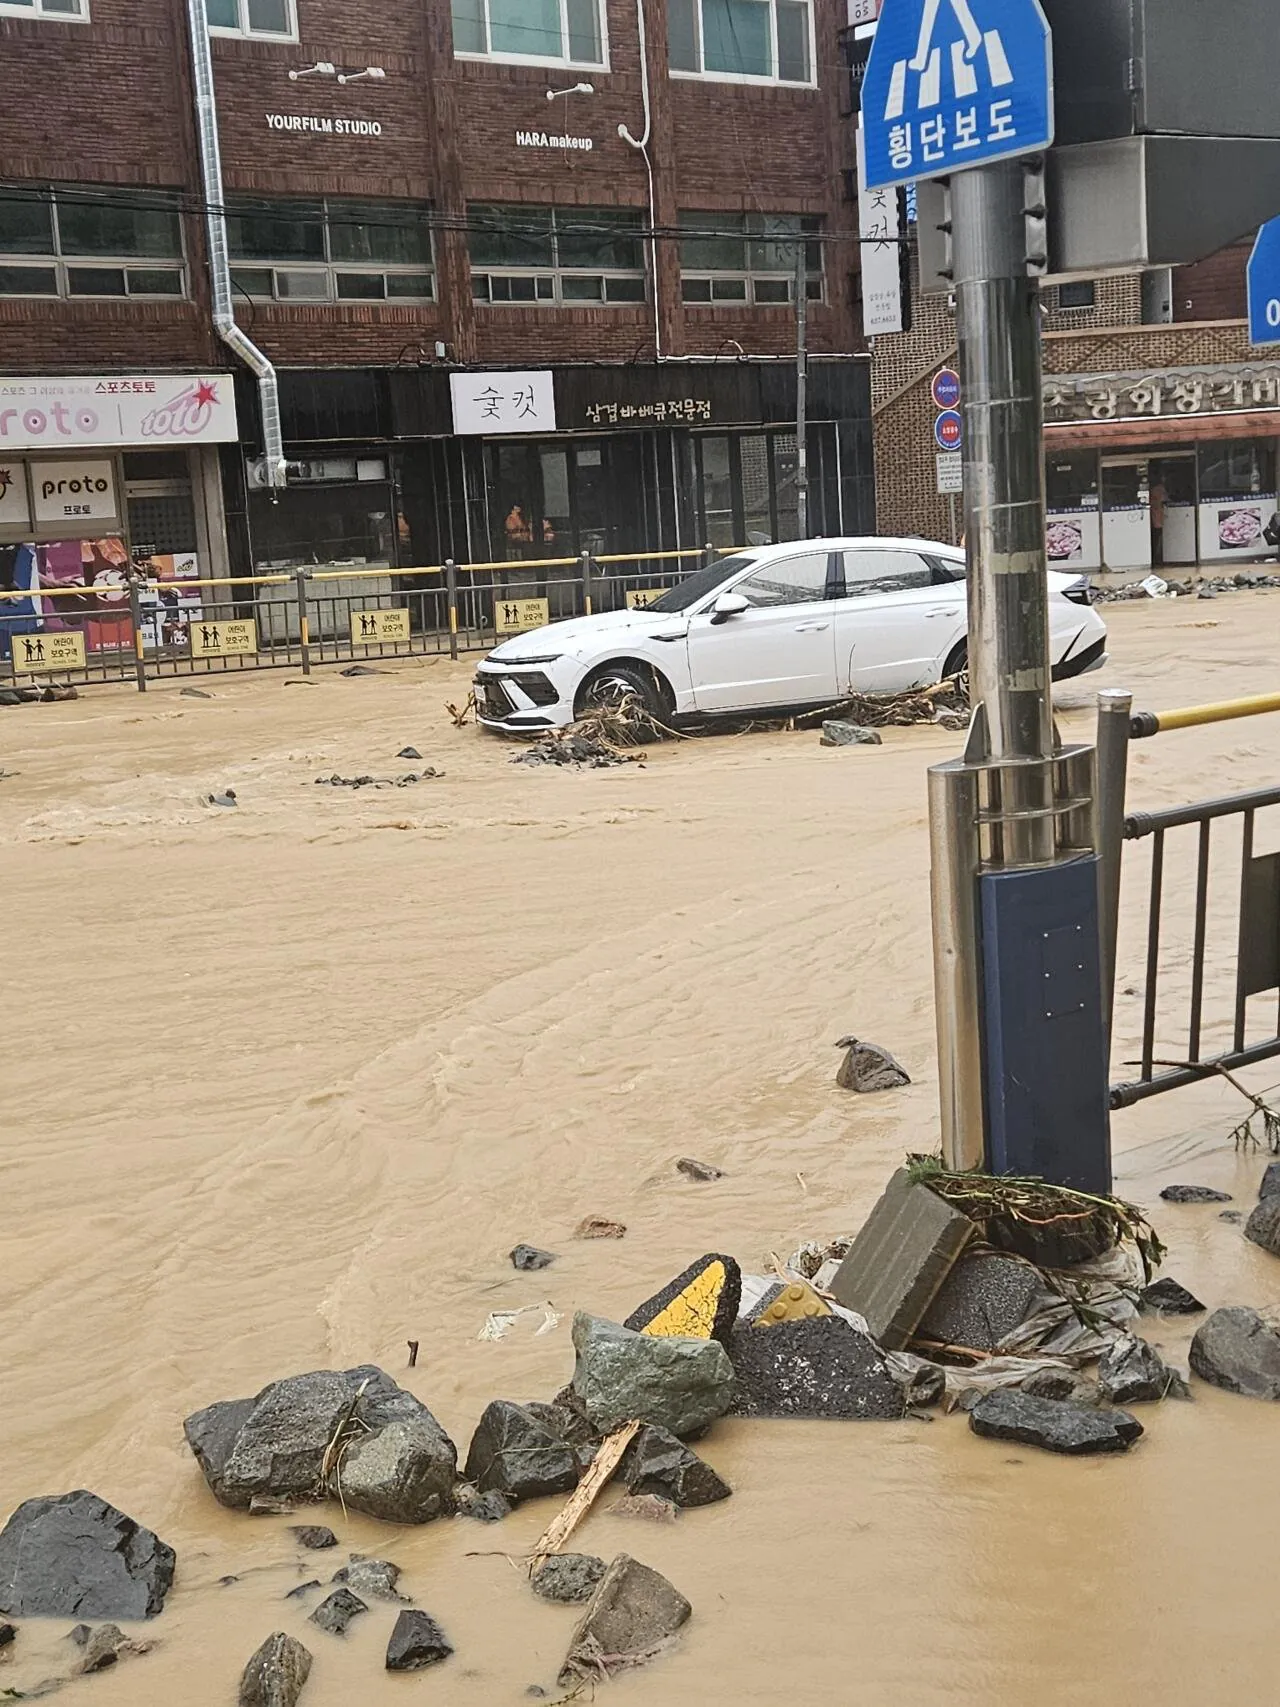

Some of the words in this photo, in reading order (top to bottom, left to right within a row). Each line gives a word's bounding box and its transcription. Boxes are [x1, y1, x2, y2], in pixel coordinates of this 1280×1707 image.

[265, 114, 332, 132] YOURFILM
[335, 121, 382, 136] STUDIO
[888, 99, 1017, 169] 횡단보도
[516, 131, 548, 147] HARA
[549, 135, 592, 151] makeup
[29, 386, 37, 395] 그
[95, 381, 156, 394] 스포츠토토
[42, 475, 108, 499] proto
[63, 504, 91, 516] 프로토
[227, 625, 245, 633] 어린이
[53, 637, 73, 646] 어린이
[225, 635, 249, 645] 보호구역
[51, 648, 78, 658] 보호구역
